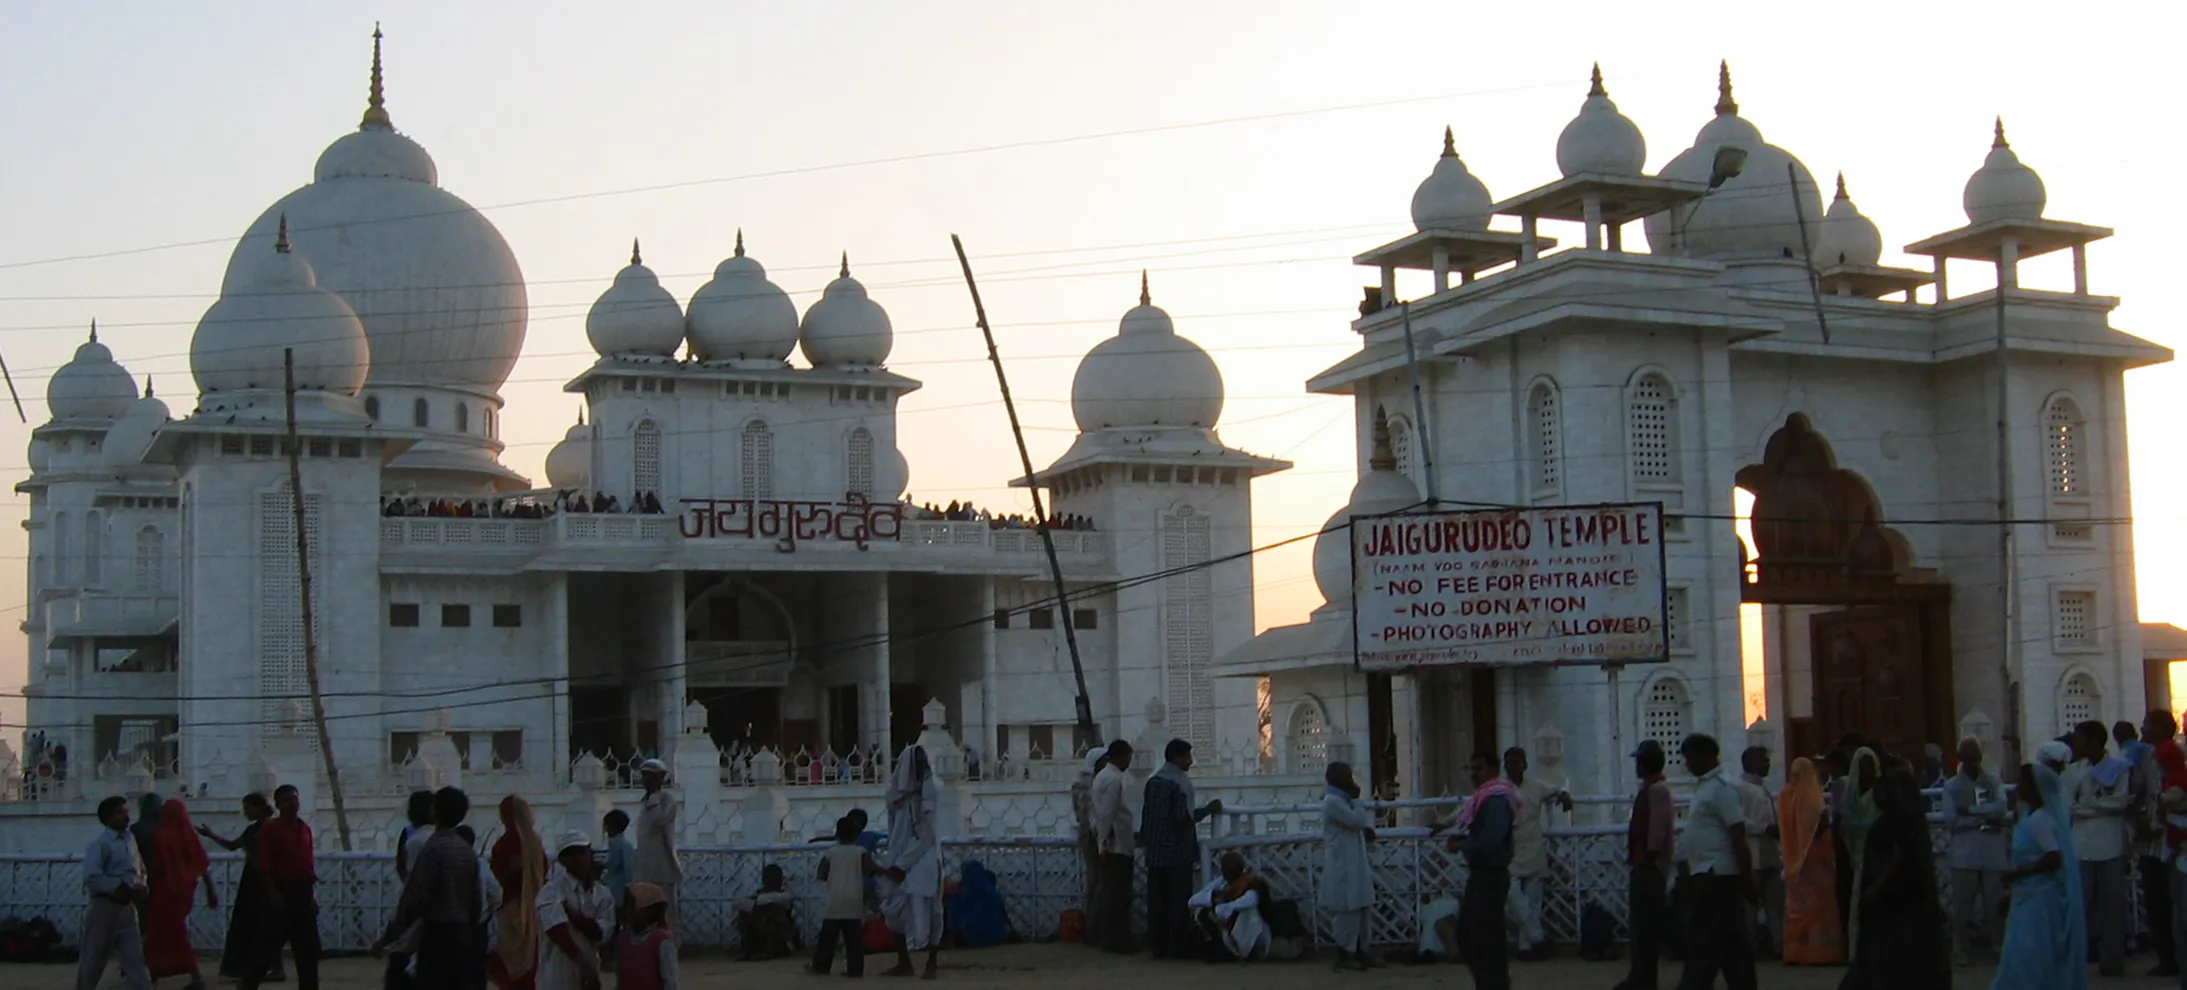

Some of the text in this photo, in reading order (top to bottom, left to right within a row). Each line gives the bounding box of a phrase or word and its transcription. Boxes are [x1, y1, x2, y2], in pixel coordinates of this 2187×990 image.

[1364, 513, 1649, 556] JAIGURUDEO TEMPLE
[1437, 576, 1479, 593] FEE
[1485, 573, 1524, 591] FOR
[1529, 569, 1636, 590] ENTRANCE
[1460, 596, 1586, 616] DONATION
[1547, 616, 1651, 637] ALLOWED
